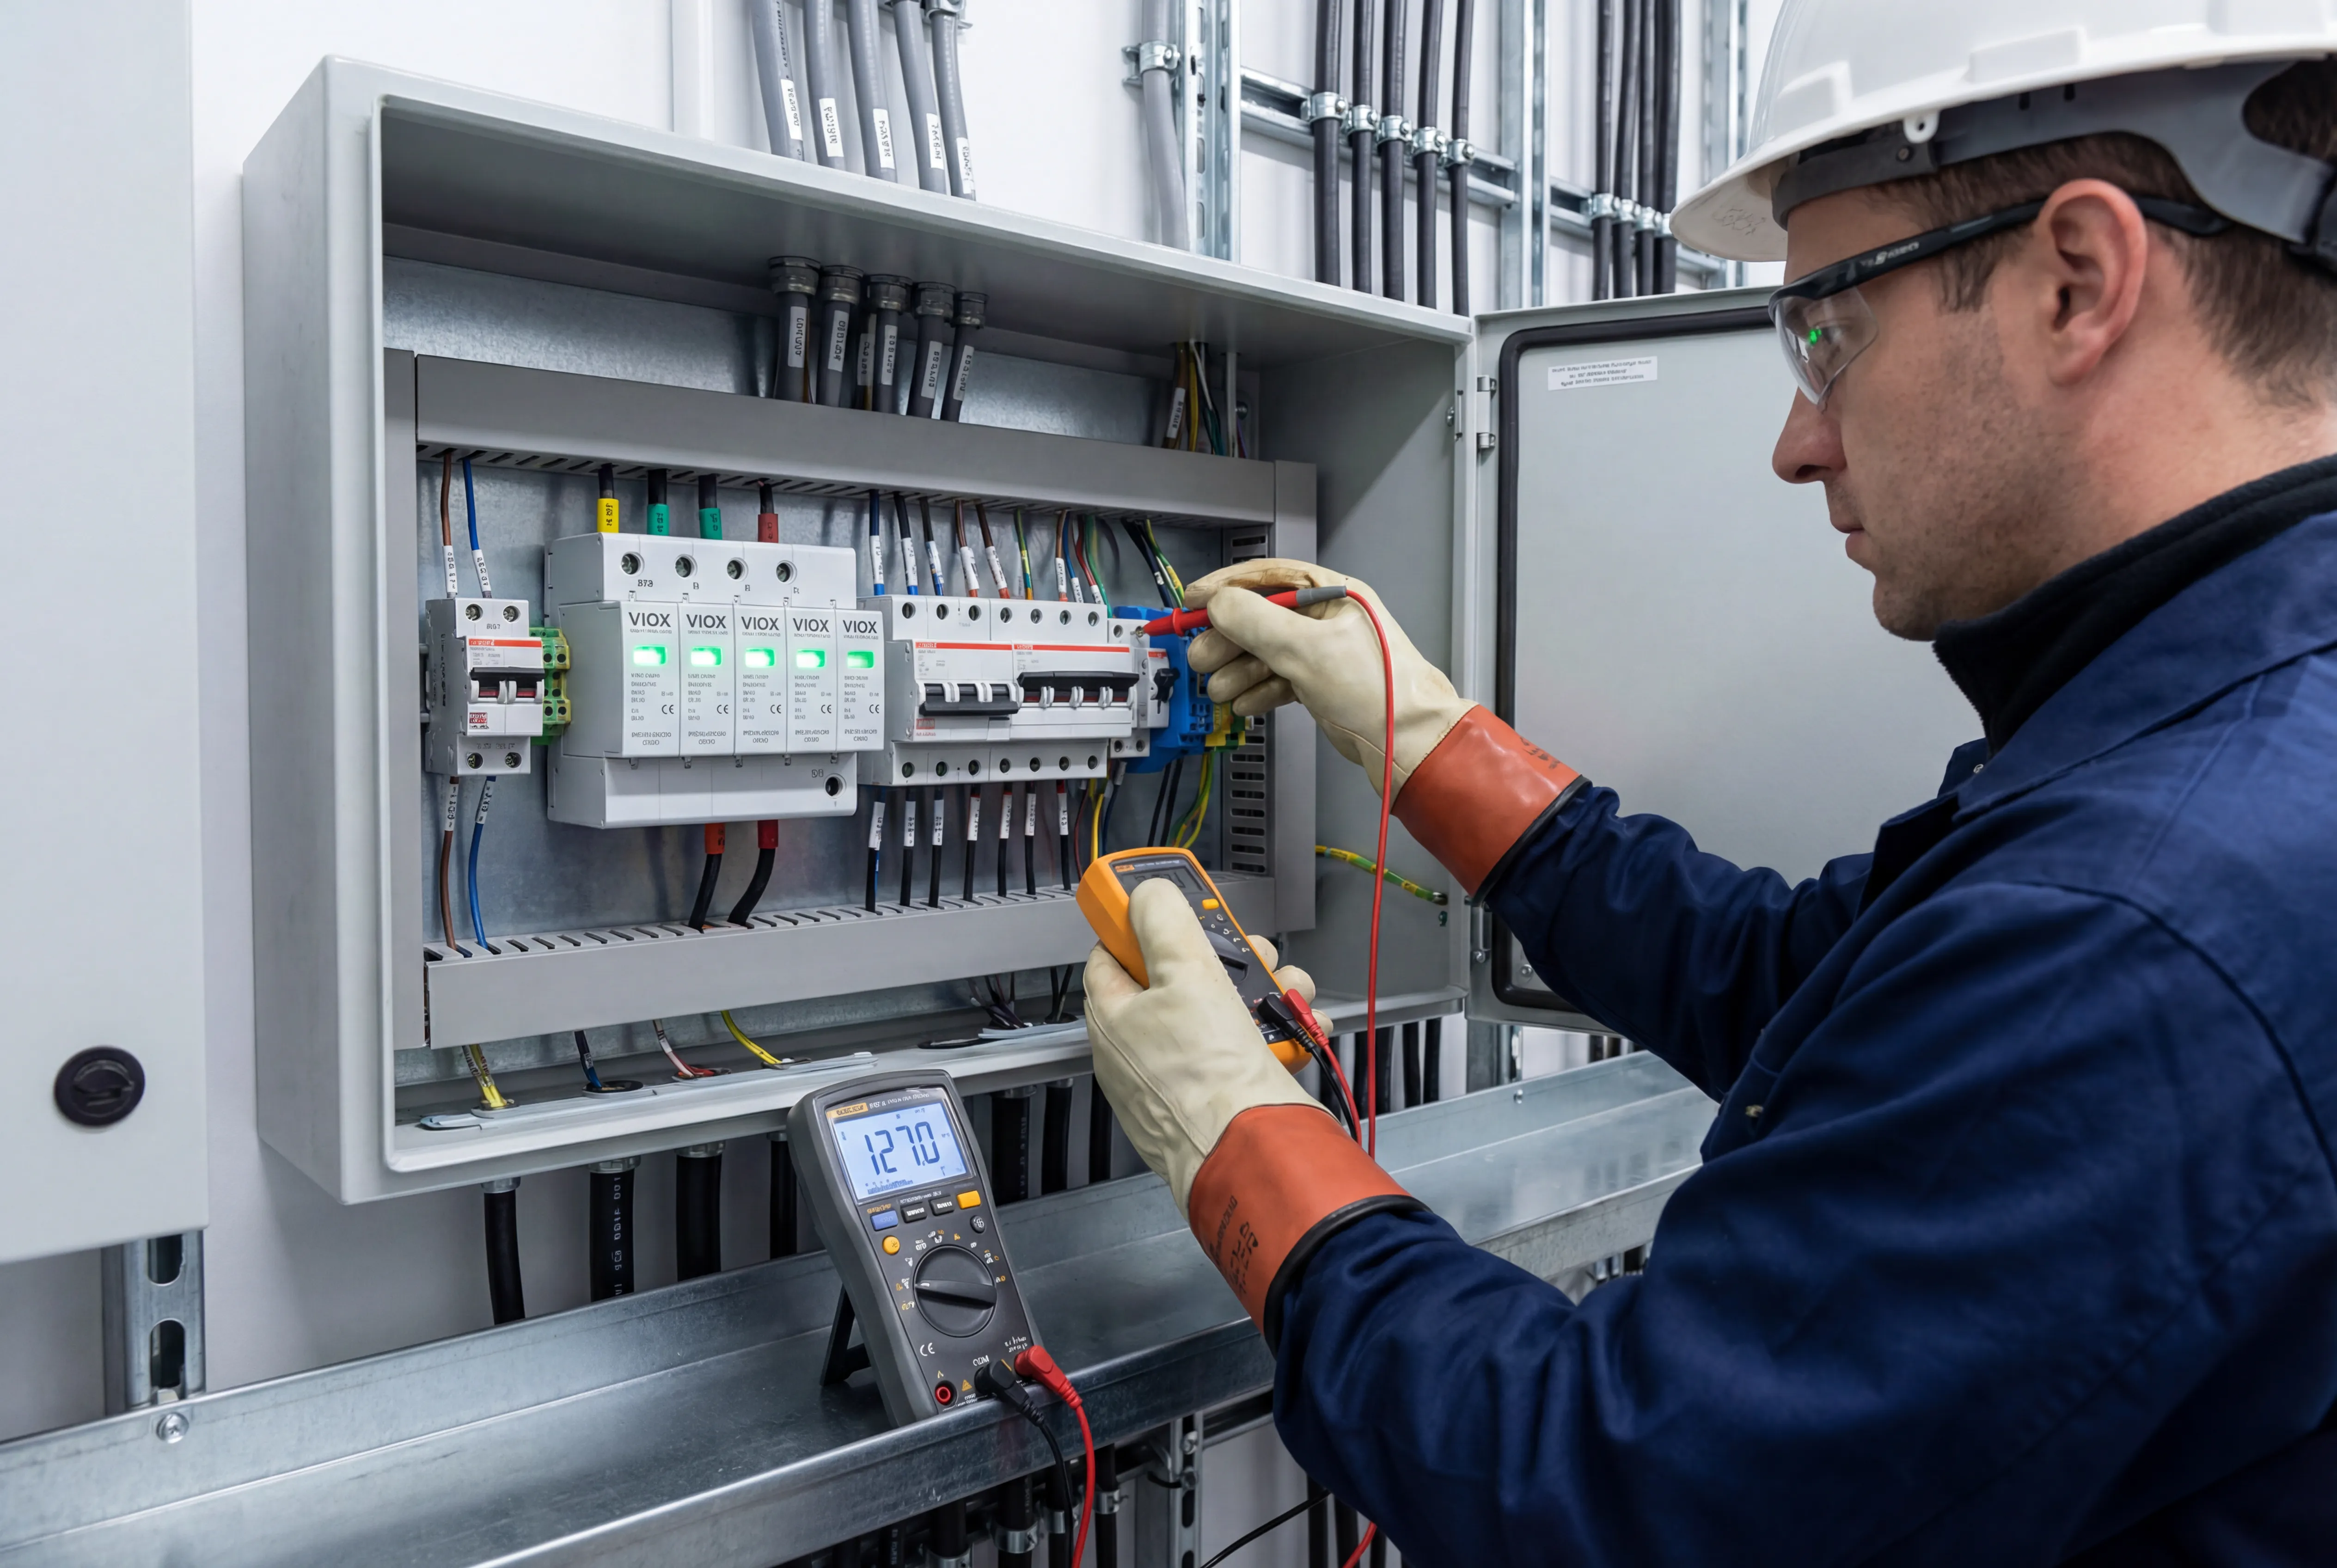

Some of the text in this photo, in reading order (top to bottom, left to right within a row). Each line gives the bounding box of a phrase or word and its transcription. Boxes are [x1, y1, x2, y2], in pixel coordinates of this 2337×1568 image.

[628, 612, 671, 628] VIOX
[686, 614, 727, 629] VIOX
[741, 617, 780, 631] VIOX
[793, 618, 829, 632] VIOX
[843, 620, 877, 634] VIOX
[661, 704, 674, 715] CE
[716, 704, 728, 714] CE
[770, 704, 782, 714] CE
[821, 704, 832, 714] CE
[869, 704, 880, 714] CE
[864, 1121, 940, 1176] 127.0
[920, 1342, 935, 1356] CE
